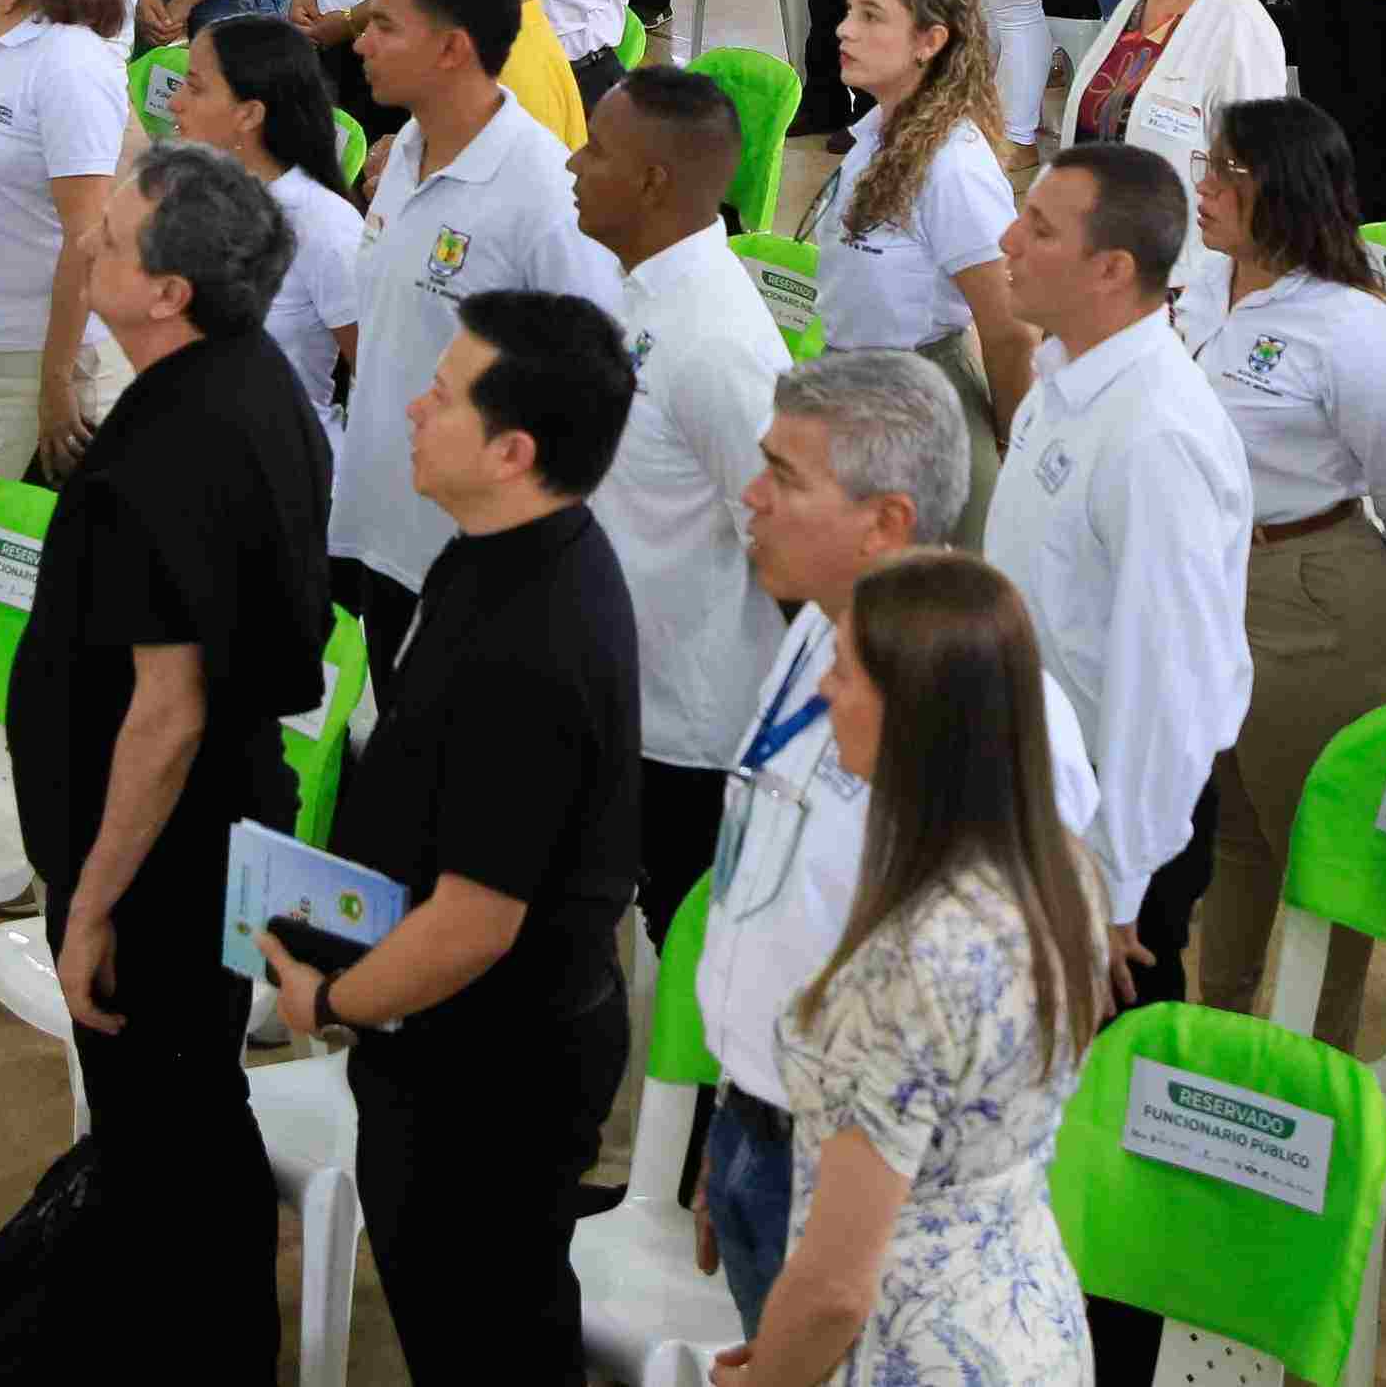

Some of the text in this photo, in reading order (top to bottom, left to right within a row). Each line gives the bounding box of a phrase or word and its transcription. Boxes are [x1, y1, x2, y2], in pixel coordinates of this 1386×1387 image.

[3, 544, 41, 565] RESERV
[1144, 1103, 1310, 1169] FUNCIONARIO PÚBLICO
[1179, 1089, 1287, 1136] RESERVADO
